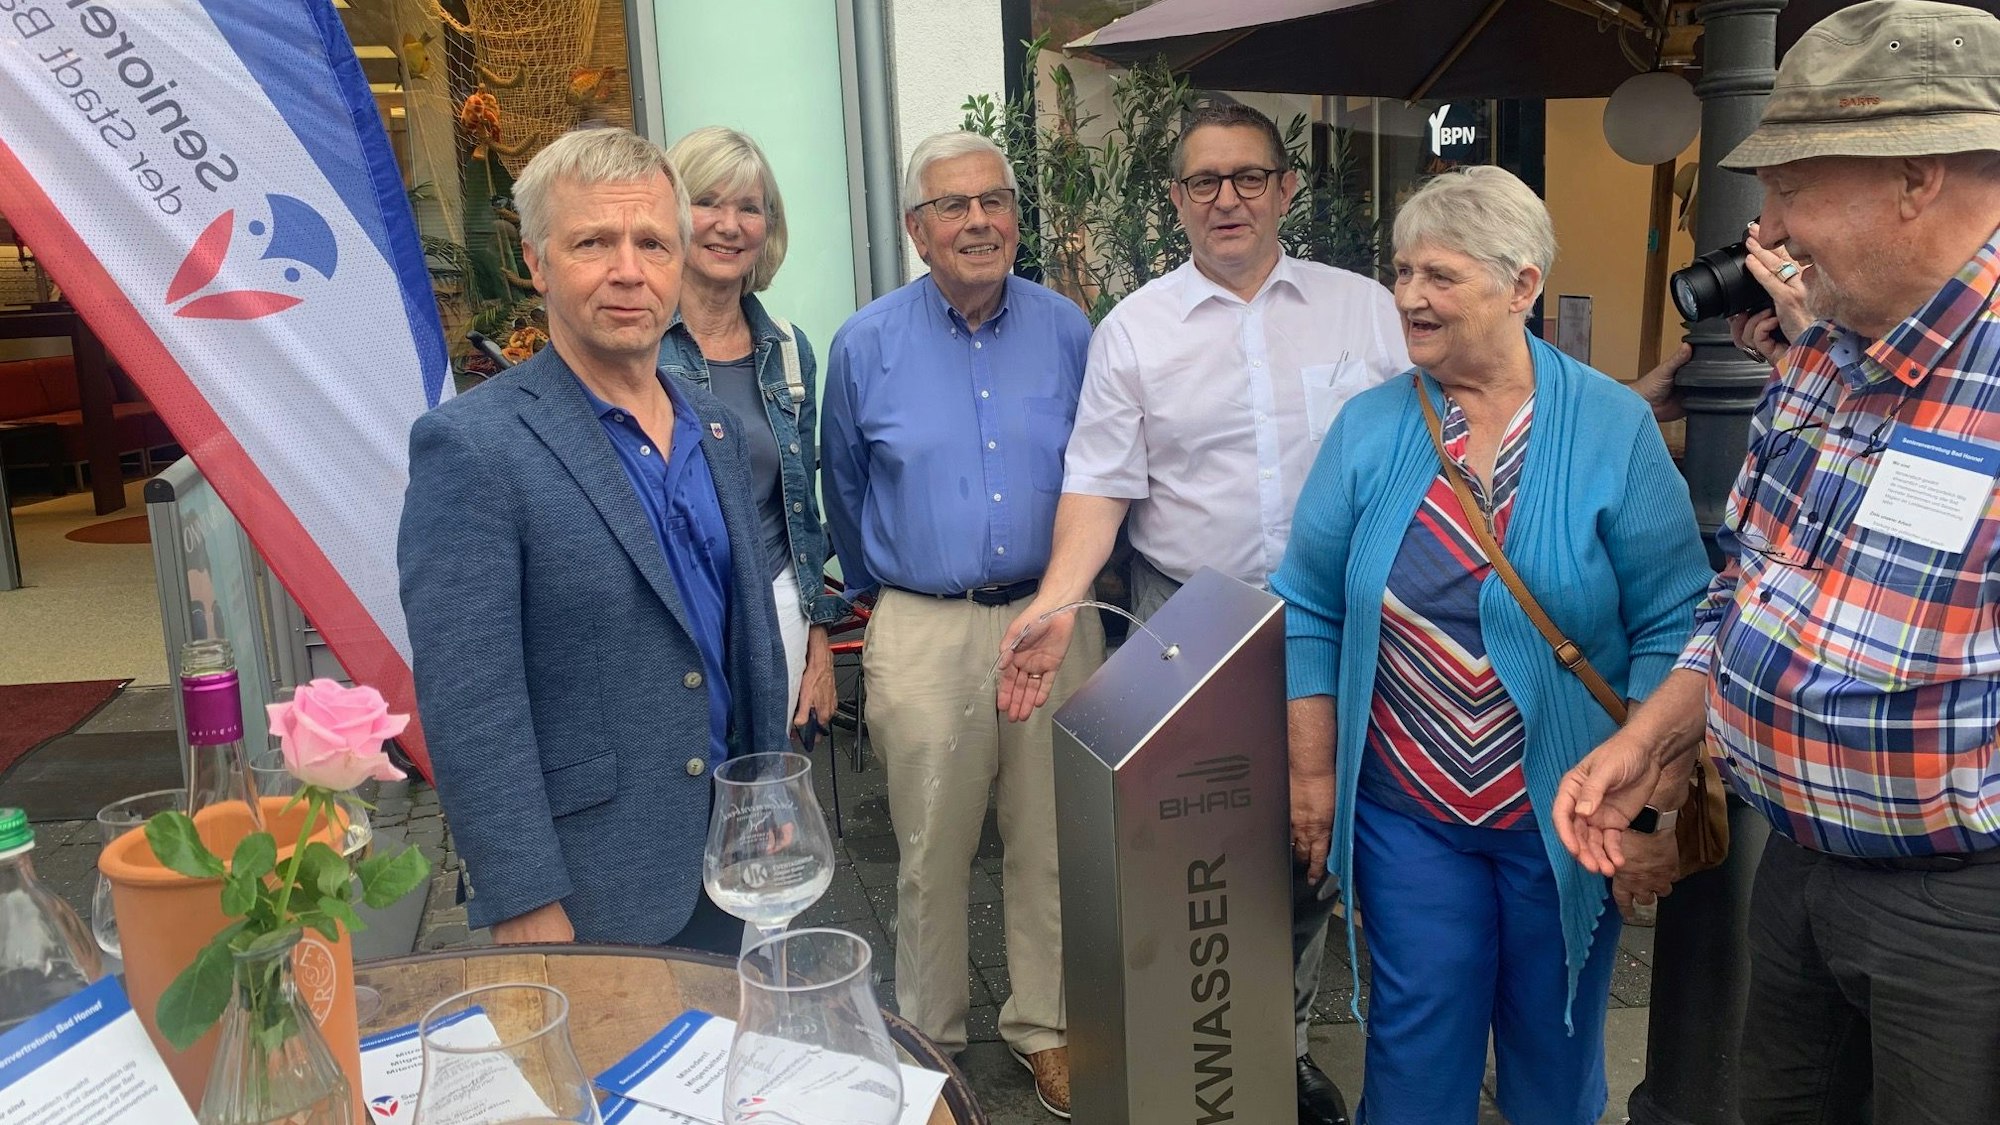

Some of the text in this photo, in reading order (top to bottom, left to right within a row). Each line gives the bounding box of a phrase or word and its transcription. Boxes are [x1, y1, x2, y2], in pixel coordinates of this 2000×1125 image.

[1159, 788, 1252, 820] BHAG
[1187, 853, 1235, 1125] KWASSER
[56, 1017, 75, 1034] Bad
[73, 999, 103, 1023] Honnef
